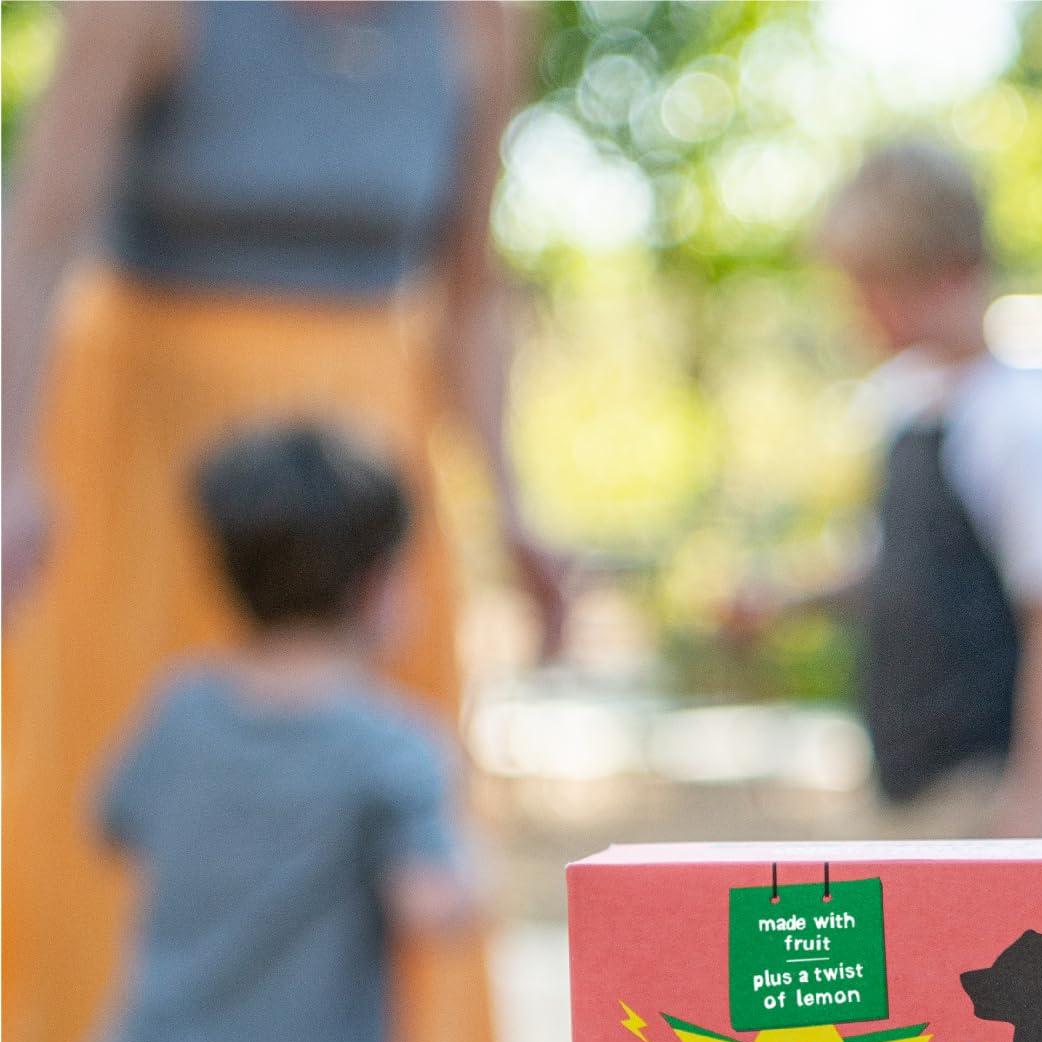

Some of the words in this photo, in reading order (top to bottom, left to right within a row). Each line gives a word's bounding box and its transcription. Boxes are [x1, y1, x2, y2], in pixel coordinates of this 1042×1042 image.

[758, 914, 806, 932] made
[813, 911, 855, 930] with
[784, 934, 831, 951] fruit
[753, 969, 793, 992] plus
[798, 970, 809, 983] a
[814, 962, 864, 982] twist
[763, 991, 786, 1010] of
[796, 988, 861, 1008] lemon
